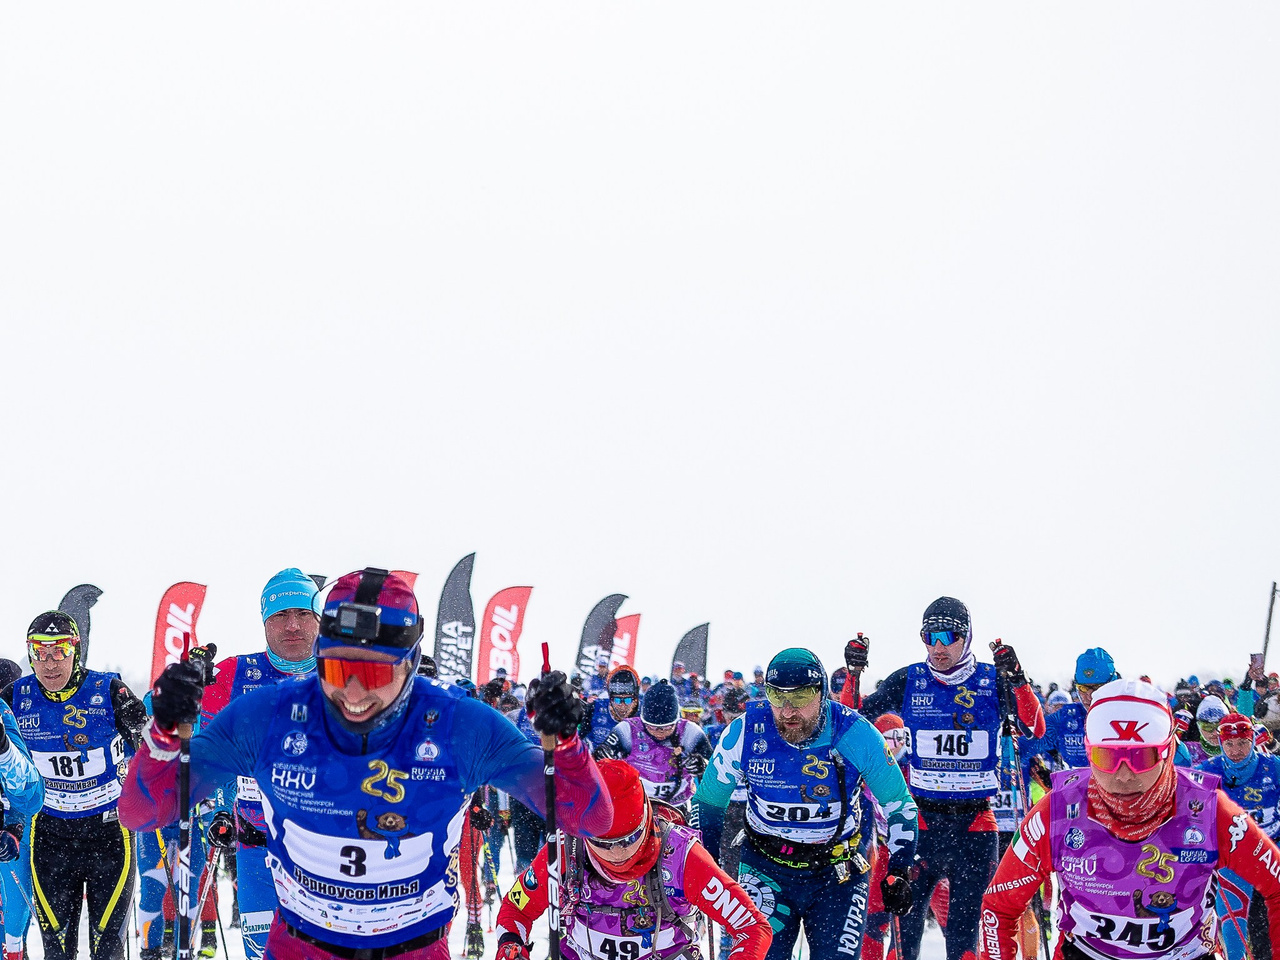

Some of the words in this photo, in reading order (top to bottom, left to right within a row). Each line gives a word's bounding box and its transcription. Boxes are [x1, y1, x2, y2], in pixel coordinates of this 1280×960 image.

[63, 704, 88, 728] 25
[933, 734, 969, 756] 146
[48, 756, 85, 777] 181
[272, 770, 317, 790] XXV
[802, 754, 831, 779] 25
[361, 759, 409, 803] 25
[339, 845, 367, 877] 3
[1136, 844, 1179, 884] 25
[294, 866, 374, 900] Черноусов
[378, 880, 419, 900] Илья
[1086, 914, 1176, 951] 345
